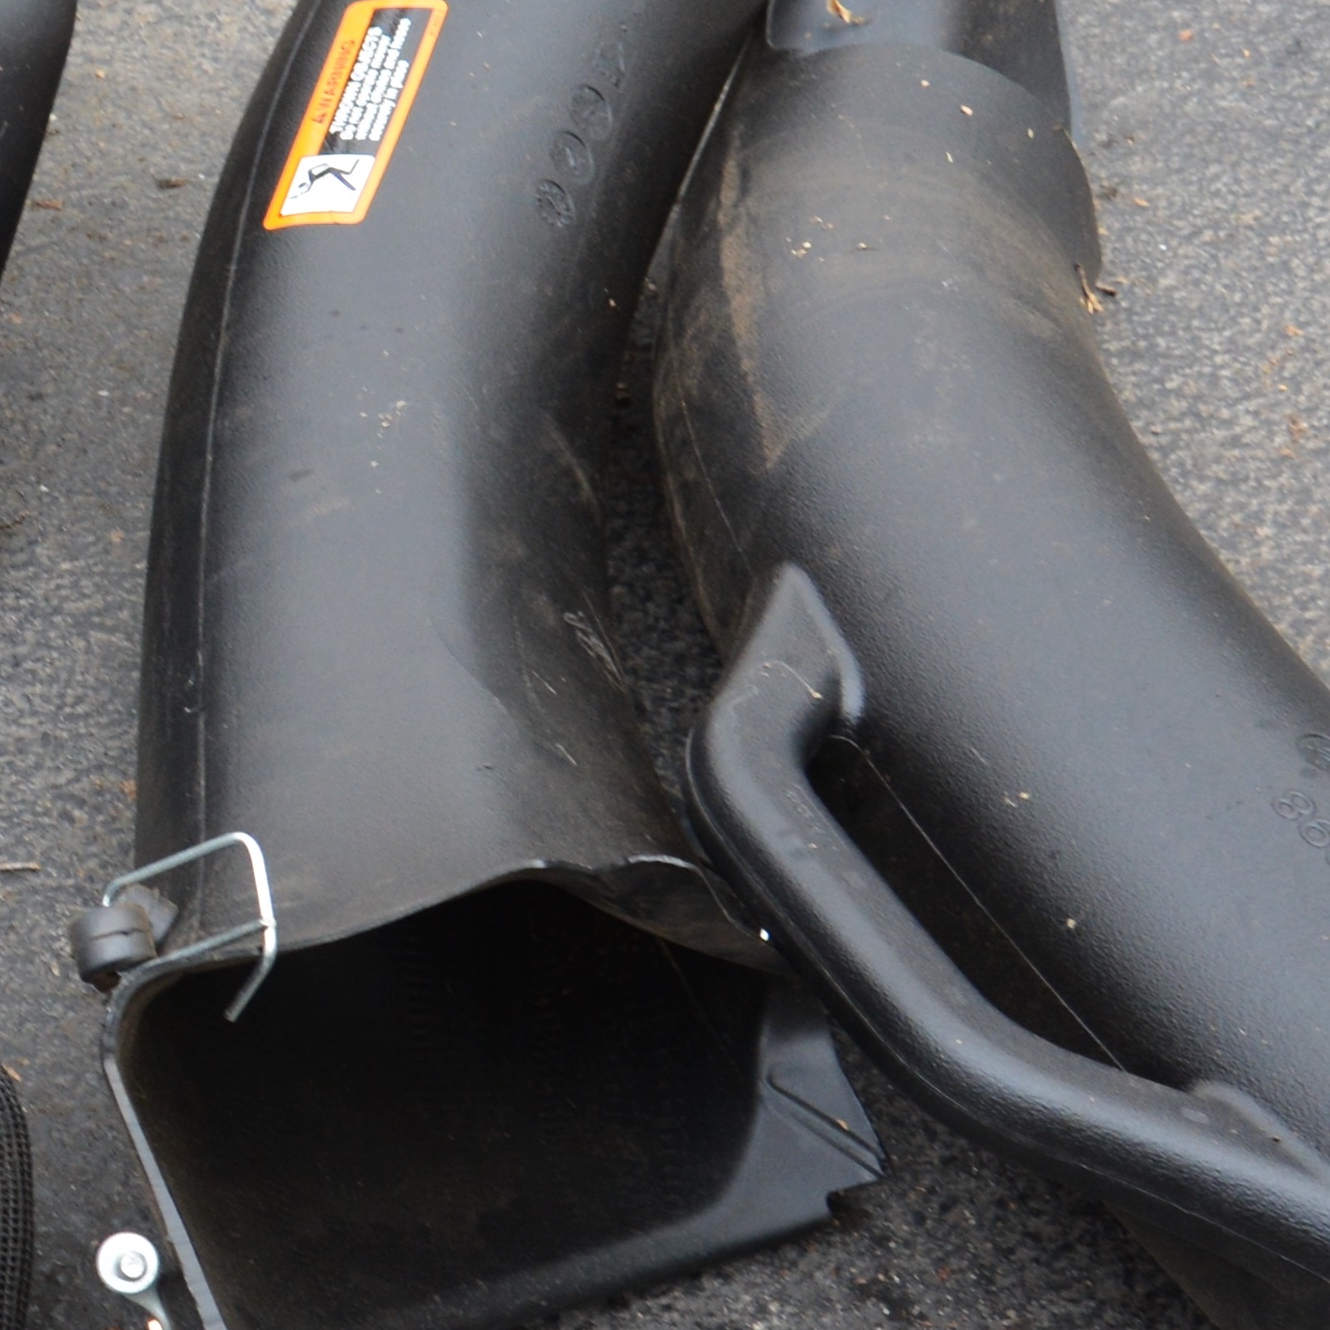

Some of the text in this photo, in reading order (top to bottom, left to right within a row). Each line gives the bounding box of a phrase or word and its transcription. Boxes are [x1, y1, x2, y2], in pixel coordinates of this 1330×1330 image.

[319, 39, 354, 108] WARNING
[328, 26, 382, 133] THROWN OBJECTS
[339, 124, 356, 139] Do
[348, 106, 363, 123] not
[356, 69, 379, 105] operate
[354, 103, 378, 139] without
